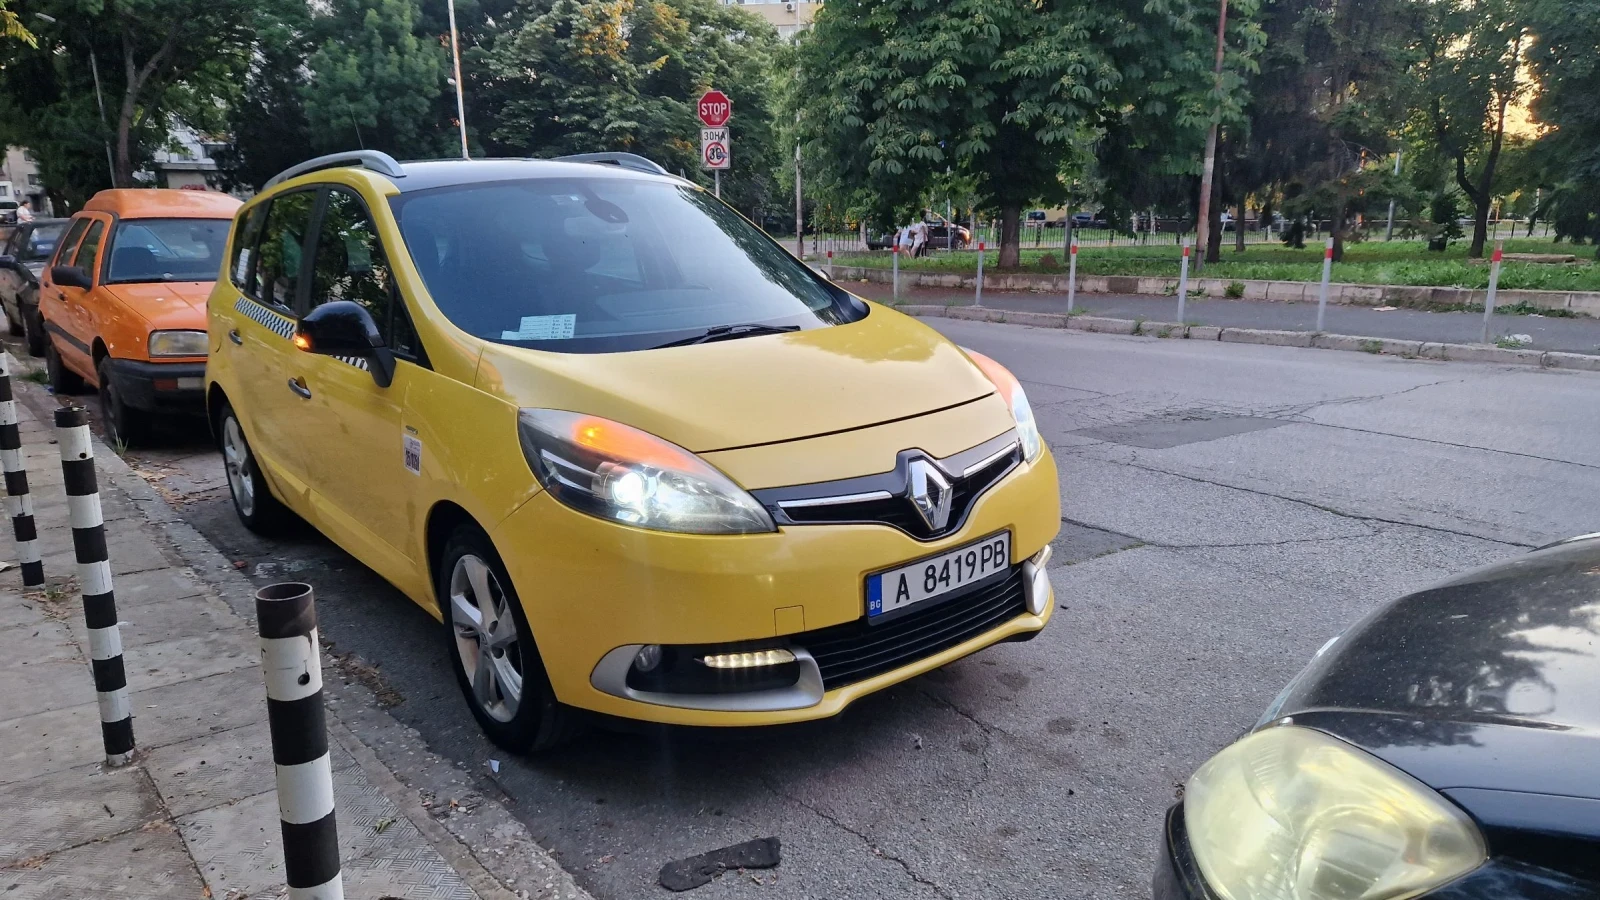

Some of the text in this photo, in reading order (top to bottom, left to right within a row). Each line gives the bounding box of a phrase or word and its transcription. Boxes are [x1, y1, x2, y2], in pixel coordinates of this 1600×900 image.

[701, 102, 727, 115] STOP
[709, 148, 722, 160] 30
[895, 573, 910, 604] A
[870, 599, 881, 610] BG
